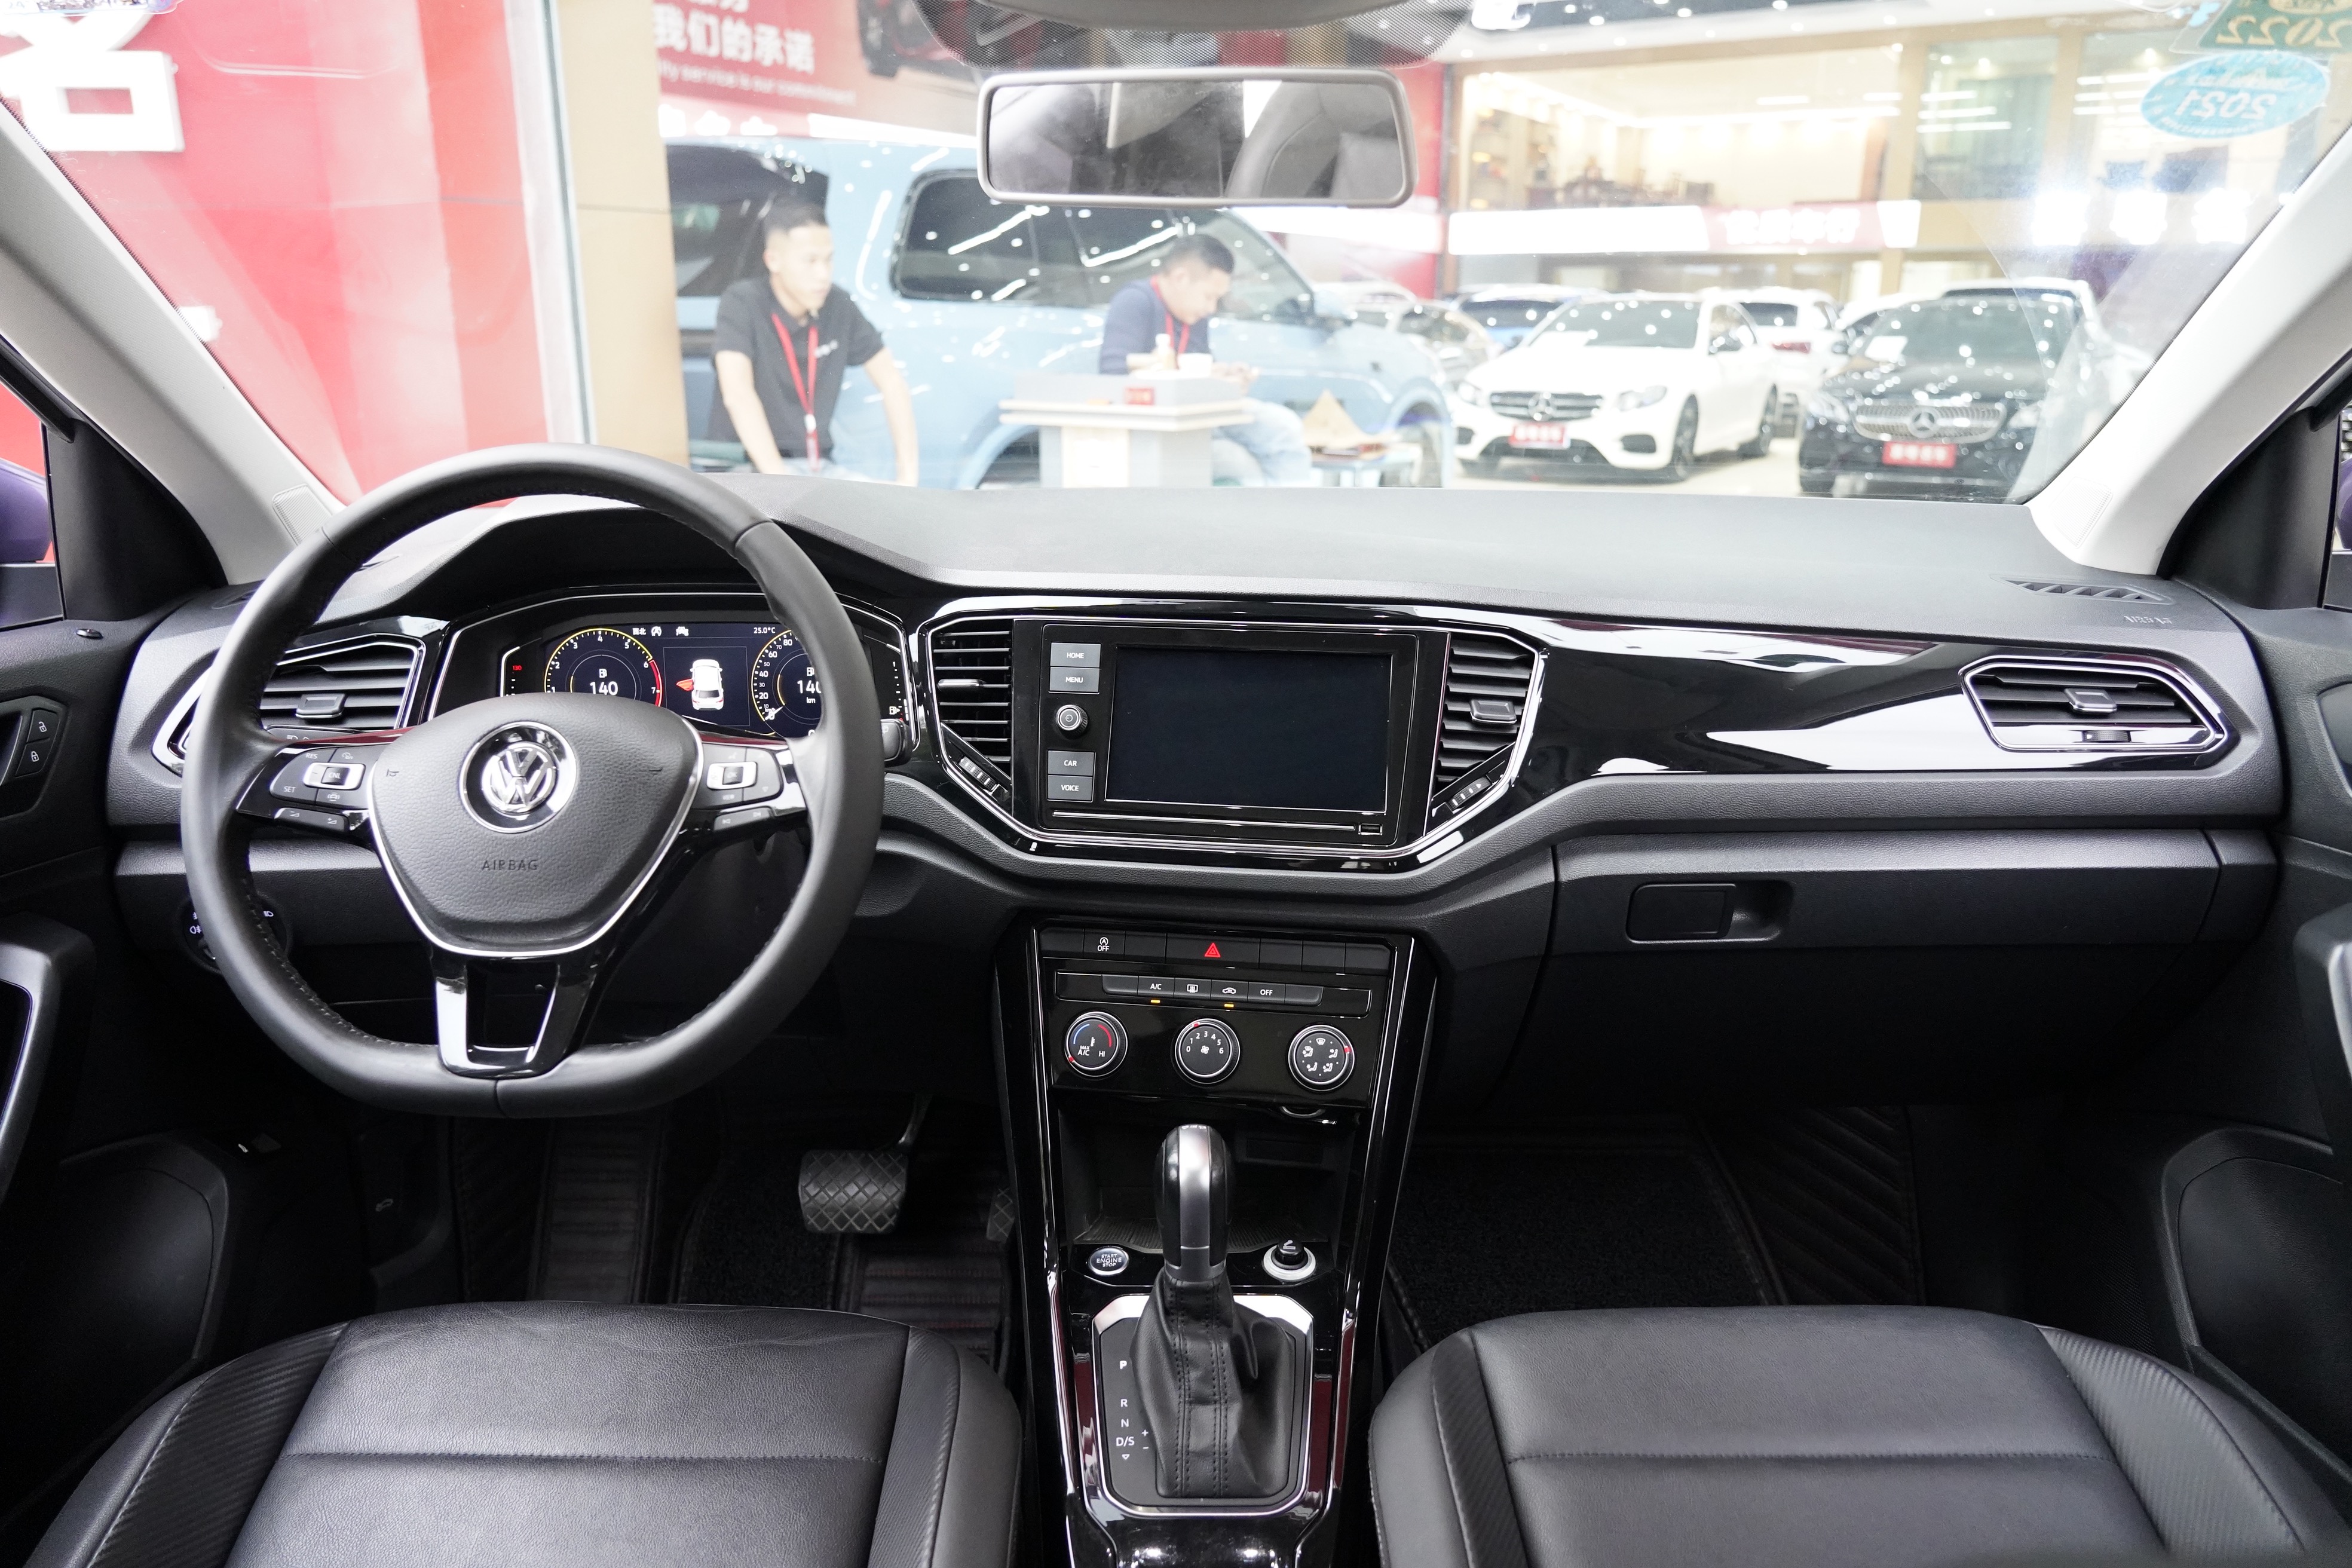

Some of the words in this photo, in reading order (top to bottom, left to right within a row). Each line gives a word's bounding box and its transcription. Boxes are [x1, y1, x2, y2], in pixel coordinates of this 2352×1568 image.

[653, 2, 815, 75] 我们的承诺
[589, 681, 618, 696] 140
[482, 859, 538, 871] AIRBAG
[1119, 1360, 1128, 1370] P
[1120, 1398, 1128, 1407] R
[1120, 1418, 1129, 1428] N
[1116, 1436, 1135, 1447] D/S
